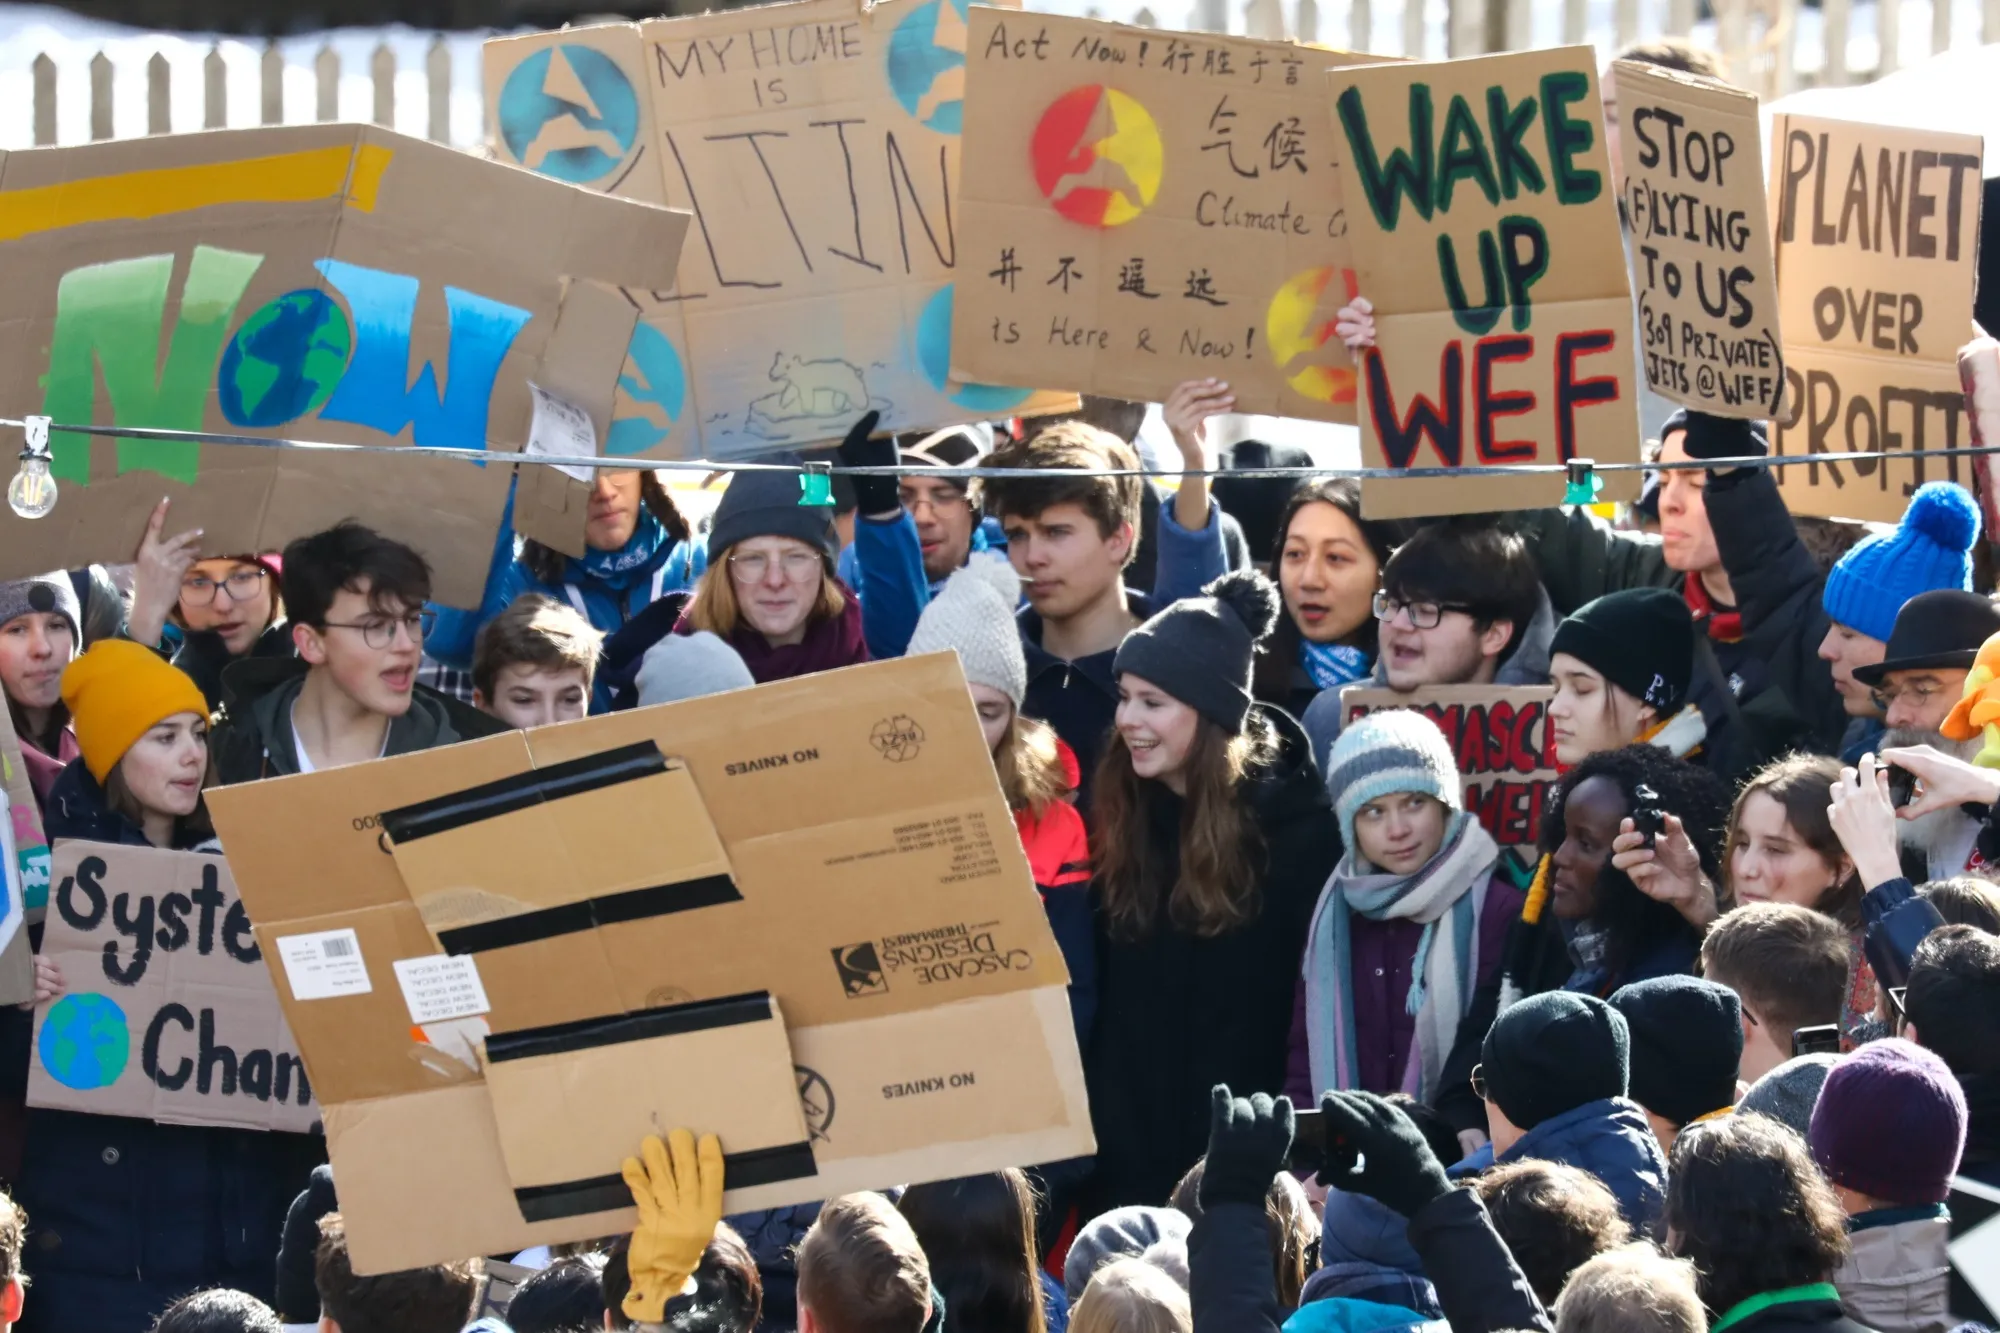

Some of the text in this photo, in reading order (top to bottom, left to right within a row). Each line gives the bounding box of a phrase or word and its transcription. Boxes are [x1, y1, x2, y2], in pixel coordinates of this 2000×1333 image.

[655, 22, 863, 88] MY HOME
[984, 21, 1146, 69] Act Now!
[753, 78, 788, 108] IS
[1336, 70, 1603, 232] WAKE
[1632, 105, 1735, 187] STOP
[1196, 190, 1311, 235] Climate
[1624, 175, 1751, 253] (F)LYING
[1782, 129, 1980, 262] PLANET
[1436, 215, 1550, 335] UP
[1640, 245, 1756, 329] TO US
[1048, 315, 1110, 350] Here
[1136, 328, 1157, 355] &
[1179, 327, 1257, 361] Now!
[1812, 286, 1923, 355] OVER
[38, 245, 533, 487] NOW
[1365, 328, 1620, 472] WEF
[1647, 351, 1690, 394] JETS
[1774, 366, 1970, 499] PROFIT
[724, 747, 820, 777] NO KNIVES
[55, 855, 263, 986] Syste
[882, 932, 996, 971] DESIGNS
[913, 947, 1033, 986] CASCADE
[141, 1002, 318, 1130] Chan
[881, 1071, 976, 1100] NO KNIVES
